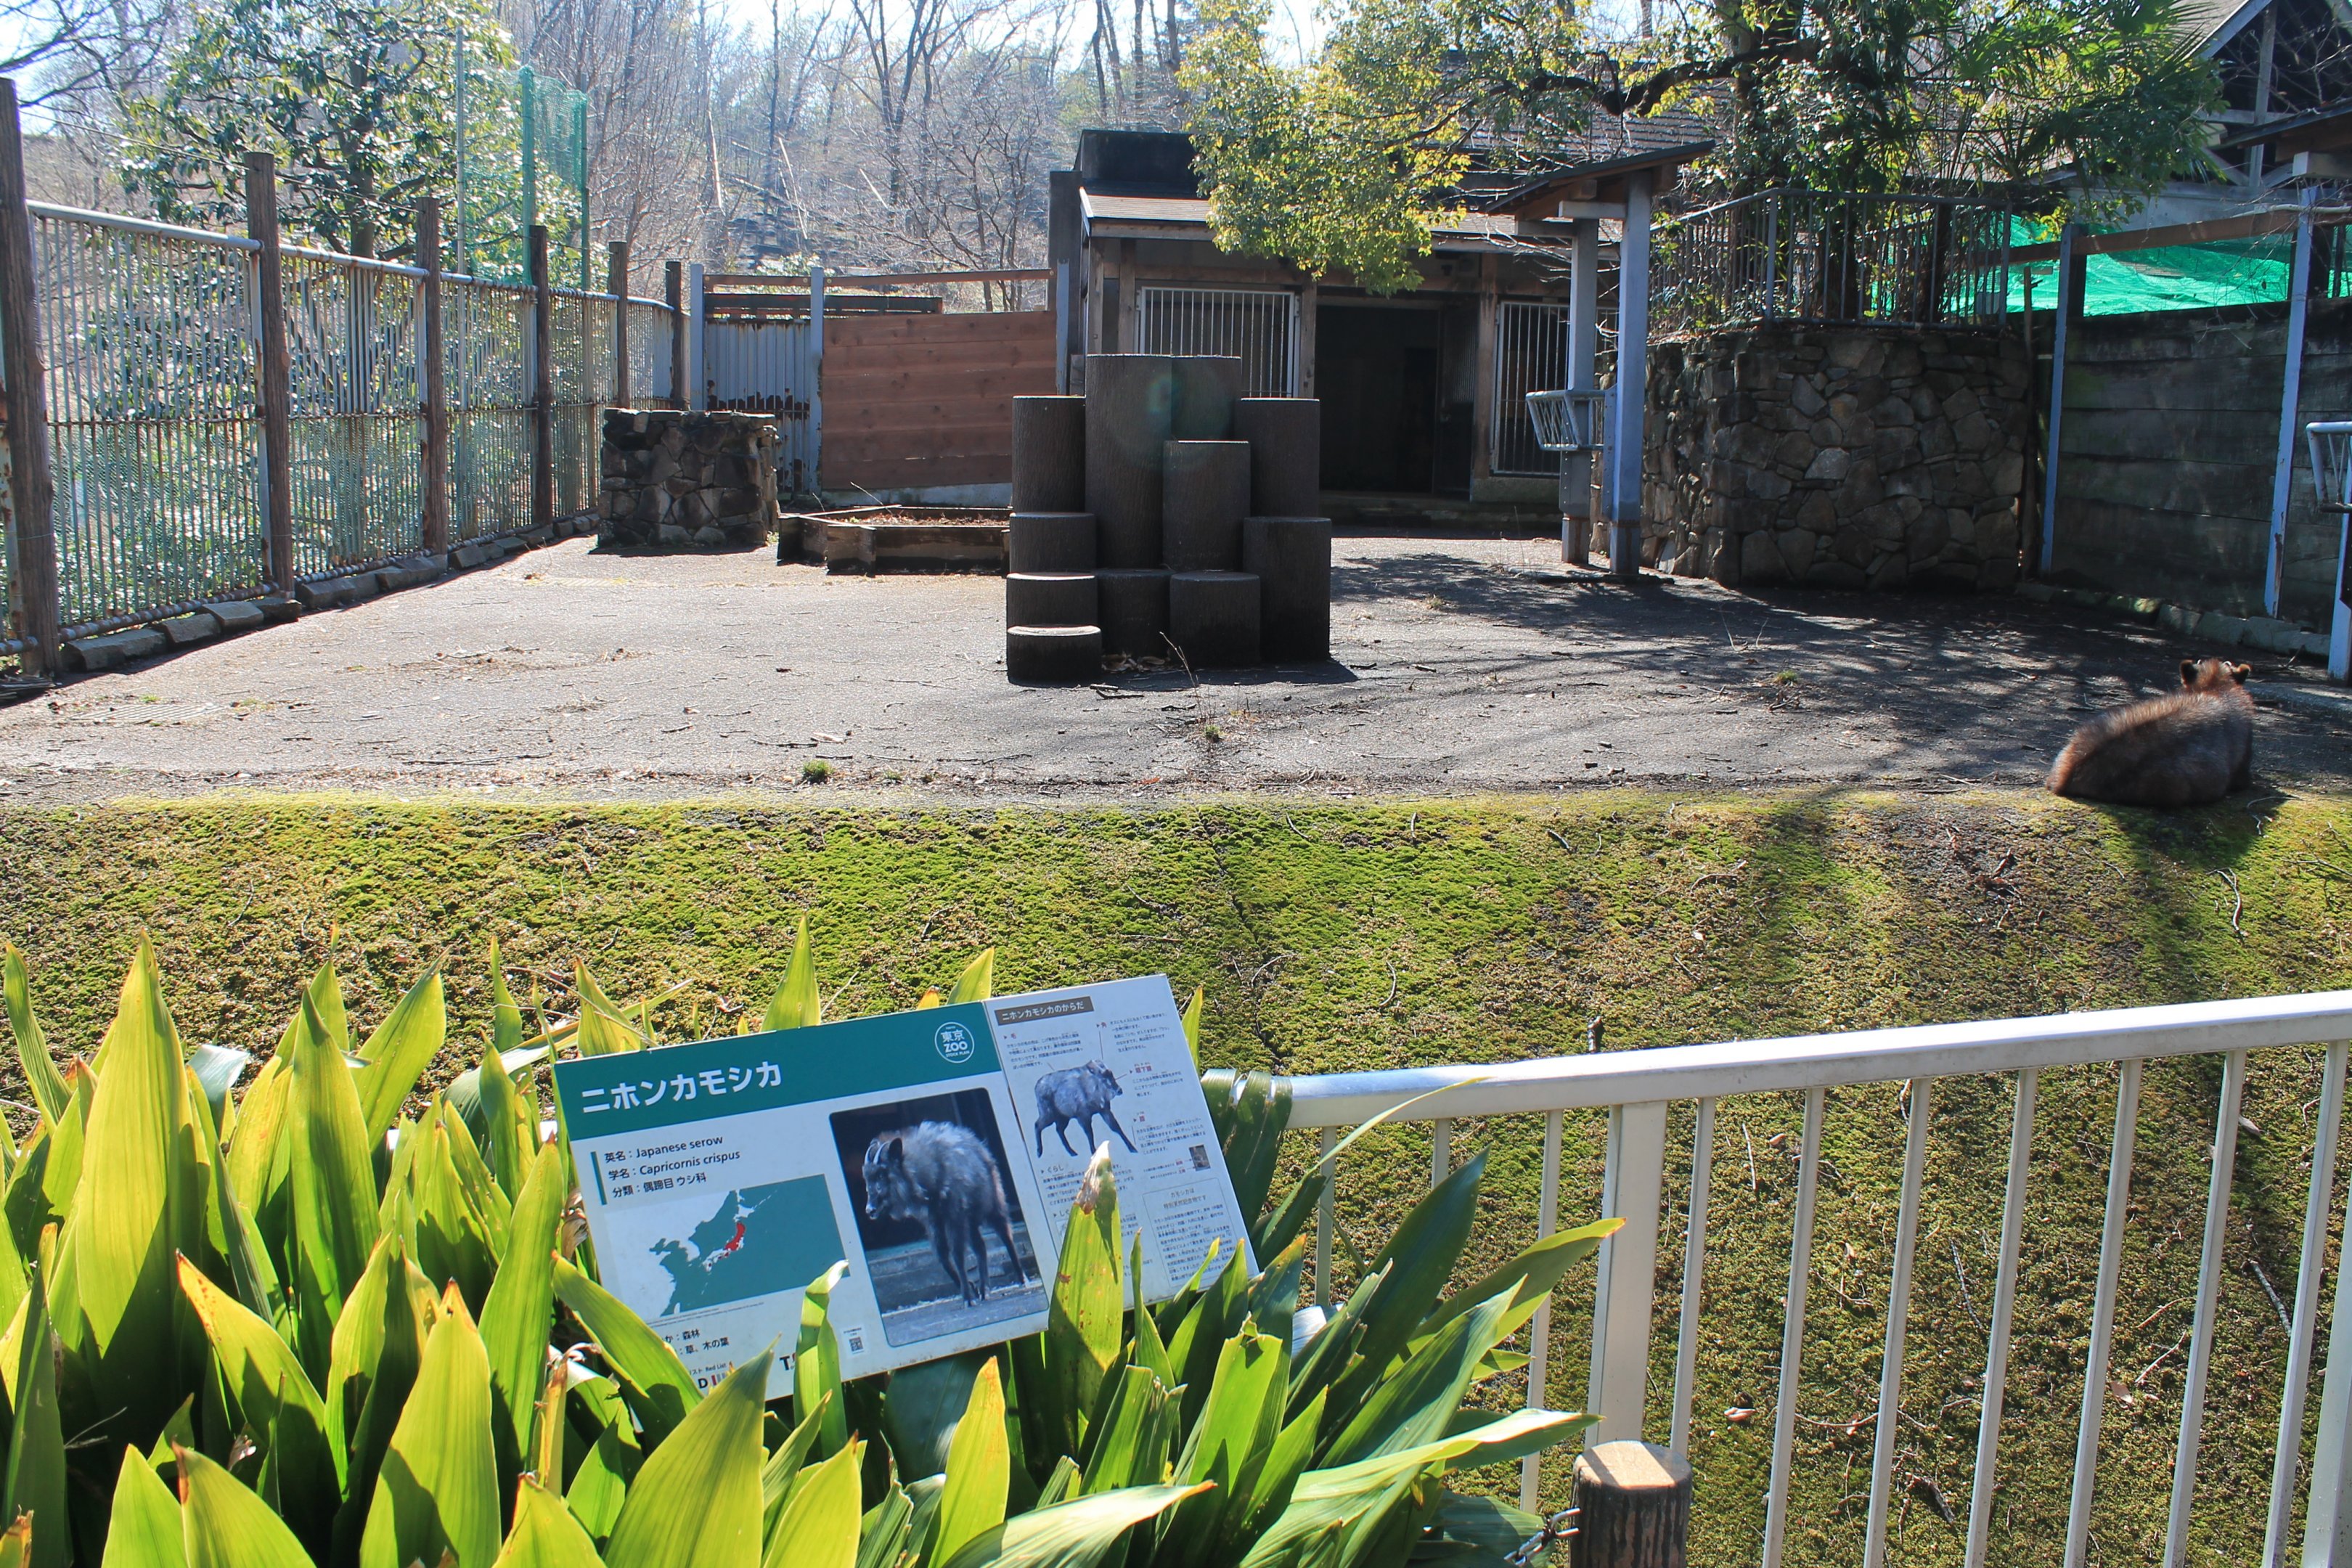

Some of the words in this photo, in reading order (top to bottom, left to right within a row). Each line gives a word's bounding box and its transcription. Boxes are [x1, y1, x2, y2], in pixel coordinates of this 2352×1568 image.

[1002, 1001, 1085, 1021] ニホンカモシカのからだ
[941, 1029, 965, 1042] 東京
[944, 1041, 968, 1053] ZOO
[581, 1061, 782, 1114] ニホンカモシカ
[636, 1142, 687, 1159] Japanese
[690, 1136, 723, 1149] serow
[640, 1156, 701, 1176] Capricornis
[703, 1151, 740, 1165] crispus
